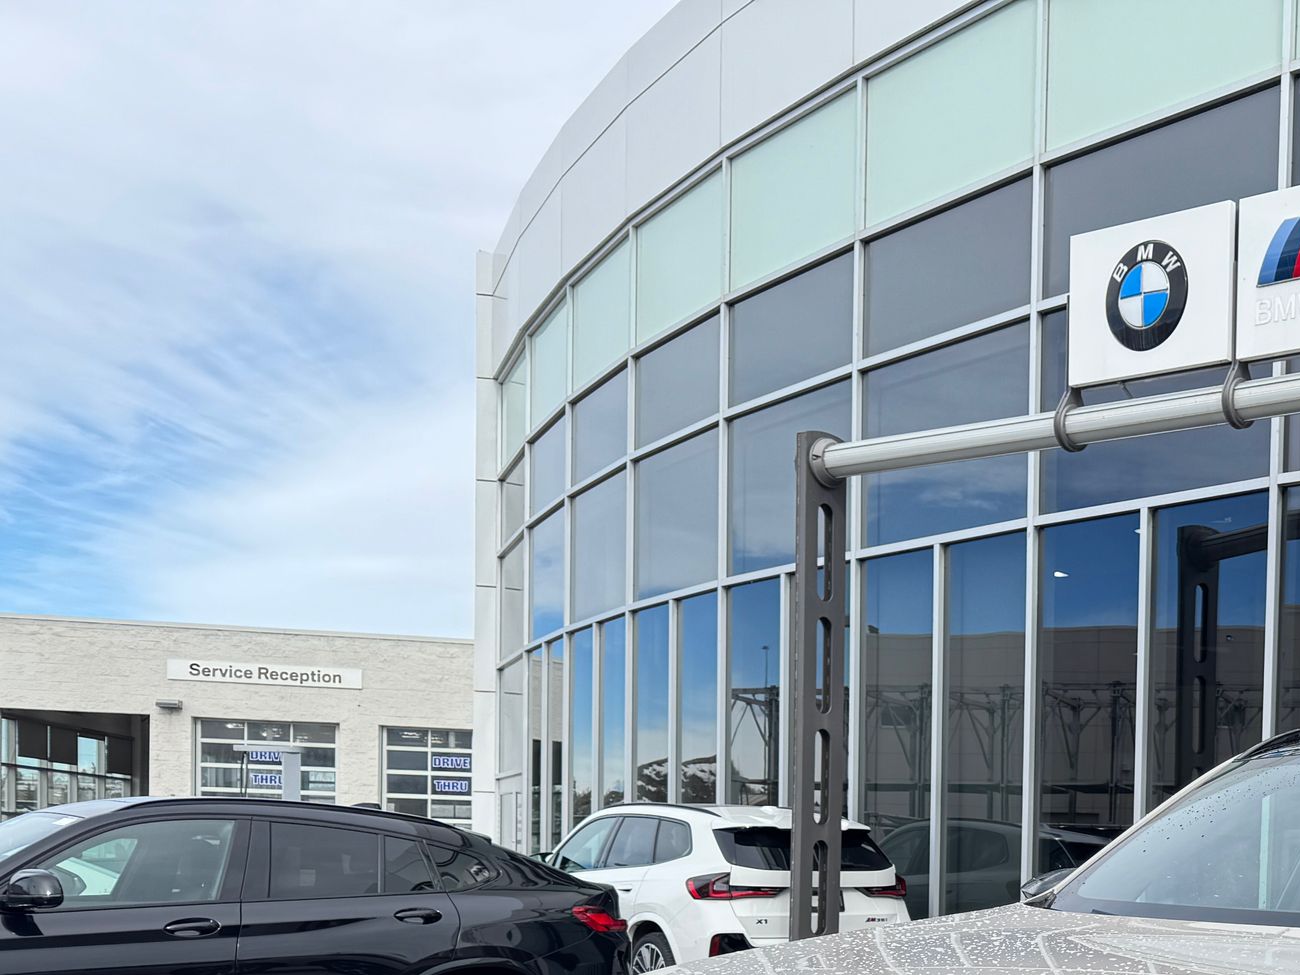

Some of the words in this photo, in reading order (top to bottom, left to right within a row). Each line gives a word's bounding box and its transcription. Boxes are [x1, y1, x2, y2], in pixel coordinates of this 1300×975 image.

[1112, 243, 1181, 283] BMW
[188, 662, 253, 680] Service
[257, 666, 342, 685] Reception
[250, 751, 281, 761] DRIV
[432, 756, 469, 769] DRIVE
[435, 779, 468, 792] THRU
